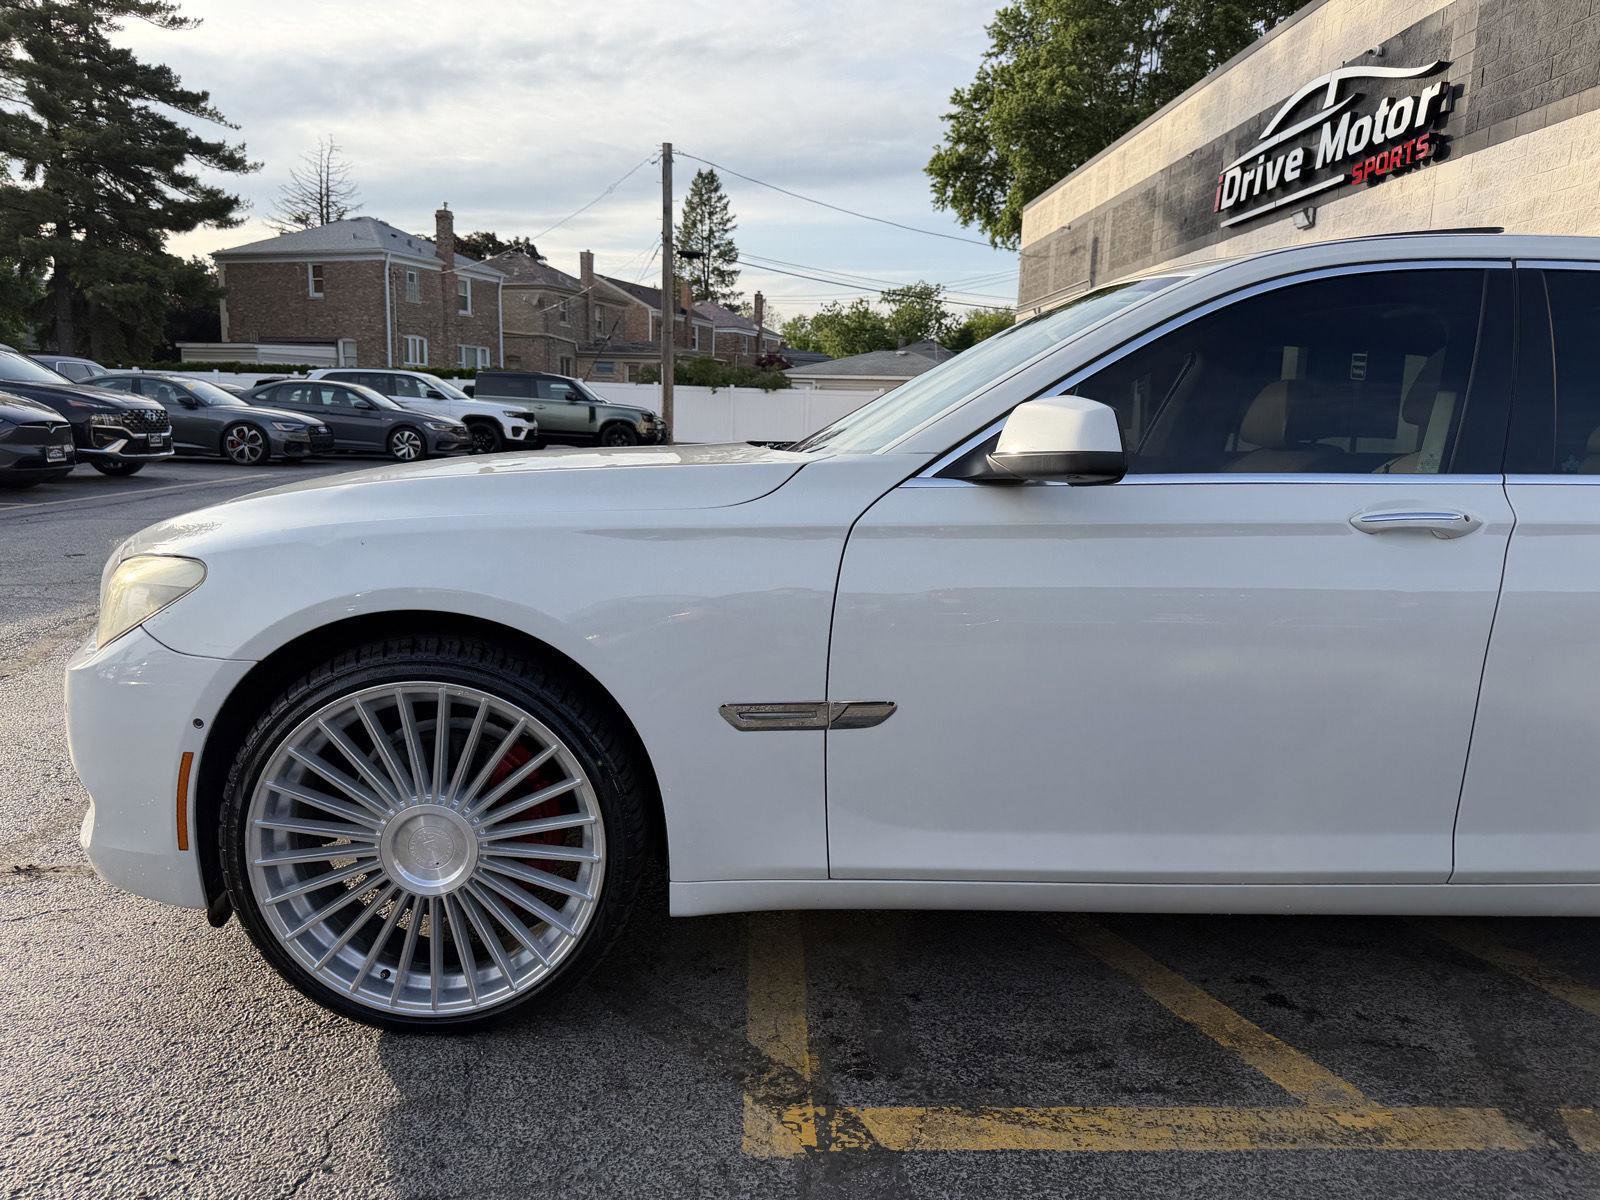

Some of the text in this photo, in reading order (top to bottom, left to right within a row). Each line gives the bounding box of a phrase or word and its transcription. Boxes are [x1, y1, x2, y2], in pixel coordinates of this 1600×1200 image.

[1214, 81, 1443, 213] iDrive Motor
[1351, 133, 1431, 186] SPORTS
